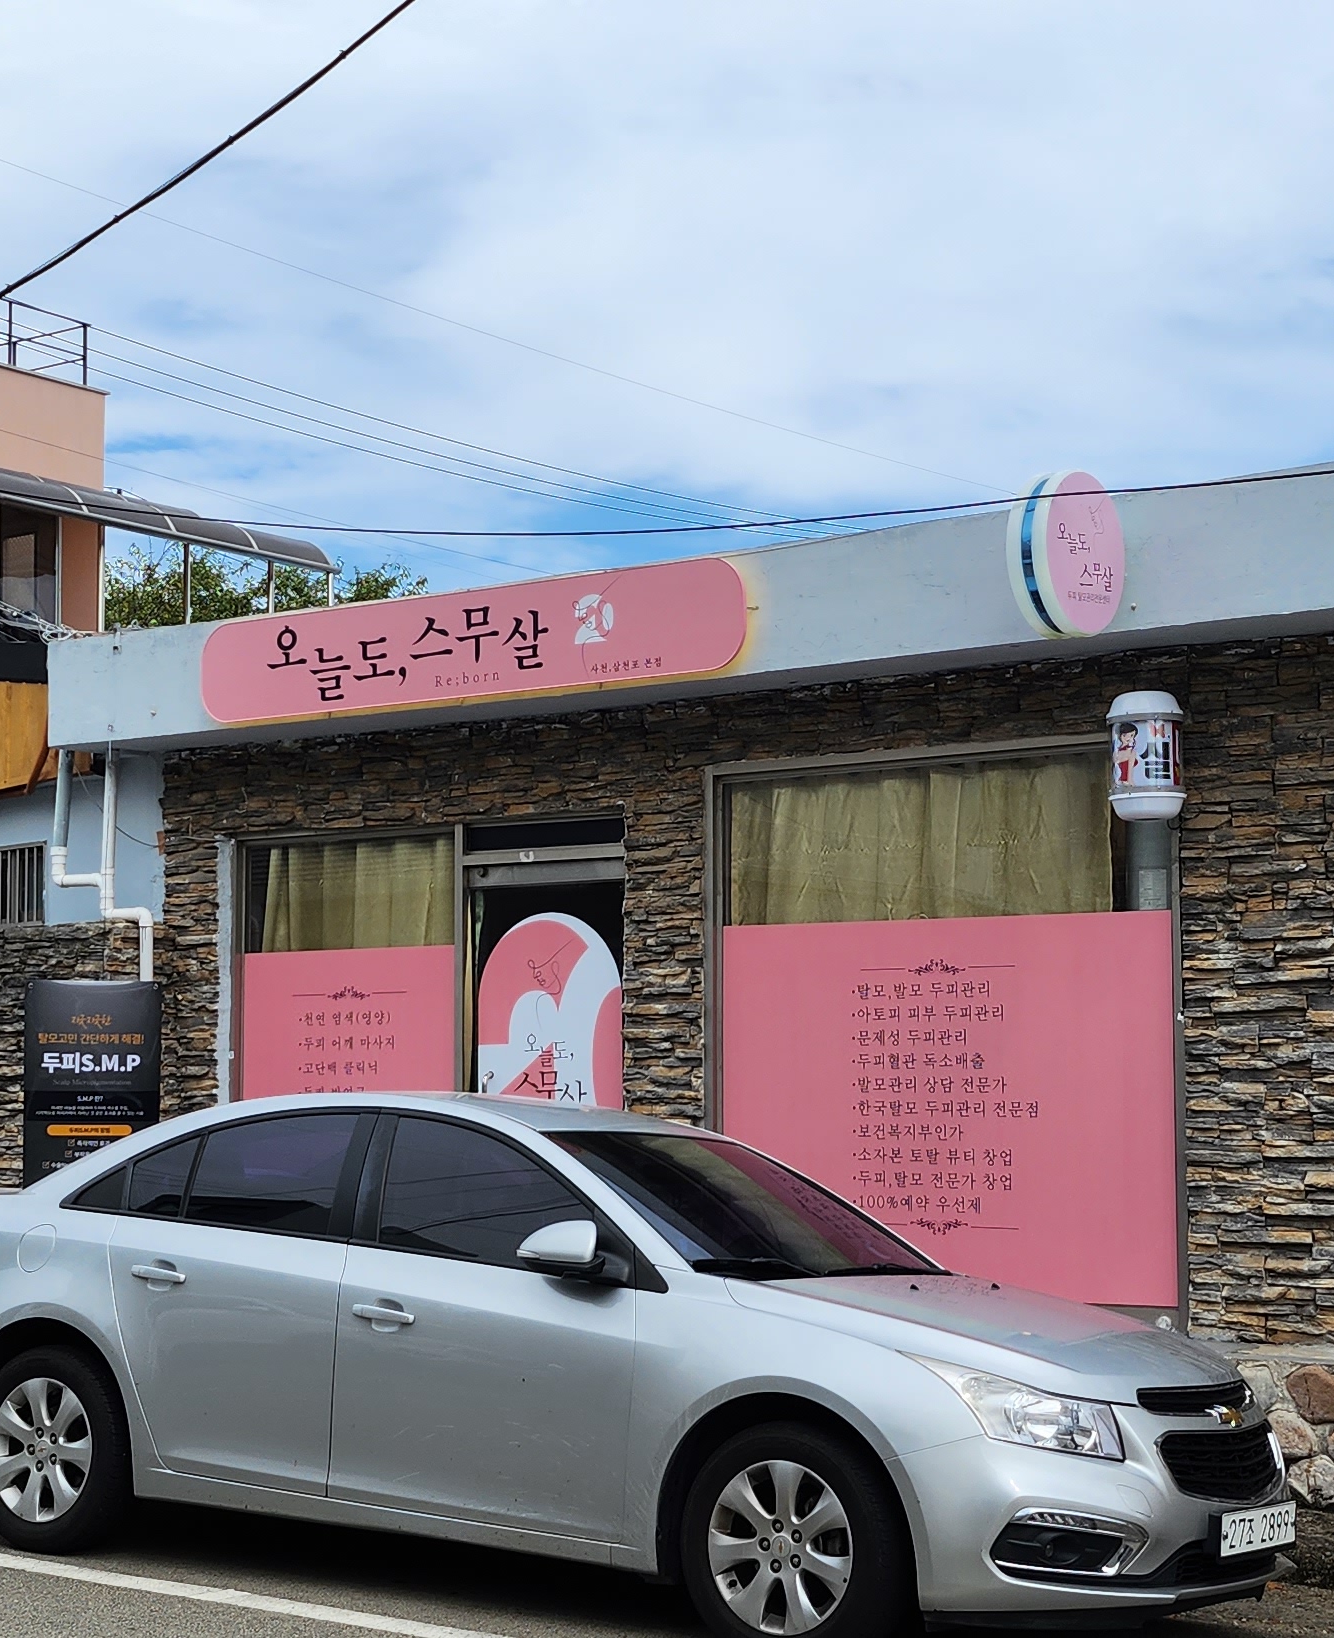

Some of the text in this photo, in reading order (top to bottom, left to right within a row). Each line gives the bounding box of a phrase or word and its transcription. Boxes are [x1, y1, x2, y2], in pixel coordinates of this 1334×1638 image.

[1057, 523, 1091, 554] 오늘도,
[1079, 563, 1114, 592] 스무살
[644, 657, 662, 669] 본점
[435, 671, 501, 688] Re;born
[929, 981, 990, 998] 두피관리
[857, 1004, 1004, 1022] 아토피 피부 두피관리
[38, 1033, 145, 1045] 탈모고민 간단하게 해결!
[304, 1037, 325, 1051] 두피
[360, 1035, 395, 1050] 마사지
[857, 1029, 967, 1046] 문제성 두피관리
[524, 1033, 574, 1067] 오늘도,
[41, 1052, 141, 1074] 두피S.M.P
[857, 1052, 985, 1069] 두피혈관 독소배출
[857, 1076, 1007, 1094] 발모관리 상담 전문가
[857, 1100, 1039, 1118] 한국탈모 두피관리 전문점
[857, 1124, 964, 1141] 보건복지부인가
[857, 1147, 1013, 1166] 소자본 토탈 뷰티 창업
[930, 1172, 976, 1190] 전문가
[982, 1173, 1013, 1191] 창업
[936, 1196, 981, 1214] 우선제
[1229, 1509, 1289, 1549] 27조 2899
